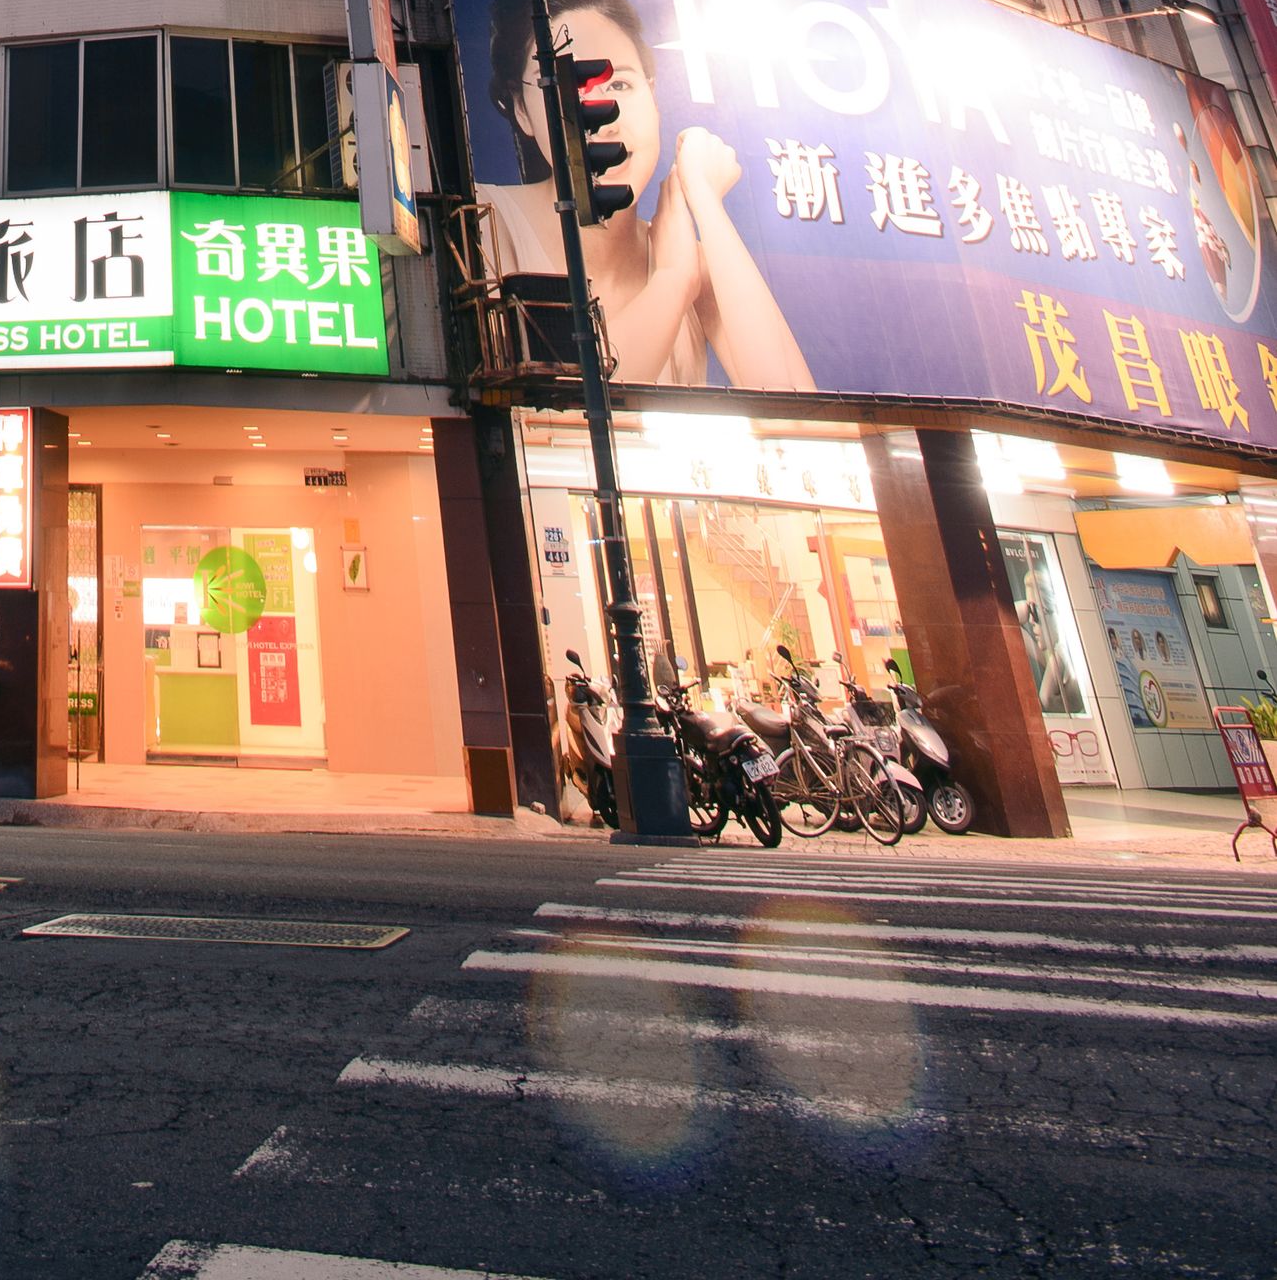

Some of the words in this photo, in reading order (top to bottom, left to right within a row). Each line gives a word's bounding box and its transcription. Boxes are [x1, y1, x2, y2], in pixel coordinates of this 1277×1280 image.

[764, 136, 1186, 281] 漸進多焦點專家
[180, 219, 374, 291] 奇異果
[39, 320, 150, 351] HOTEL
[193, 295, 379, 350] HOTEL
[1004, 547, 1040, 559] BVLGRI
